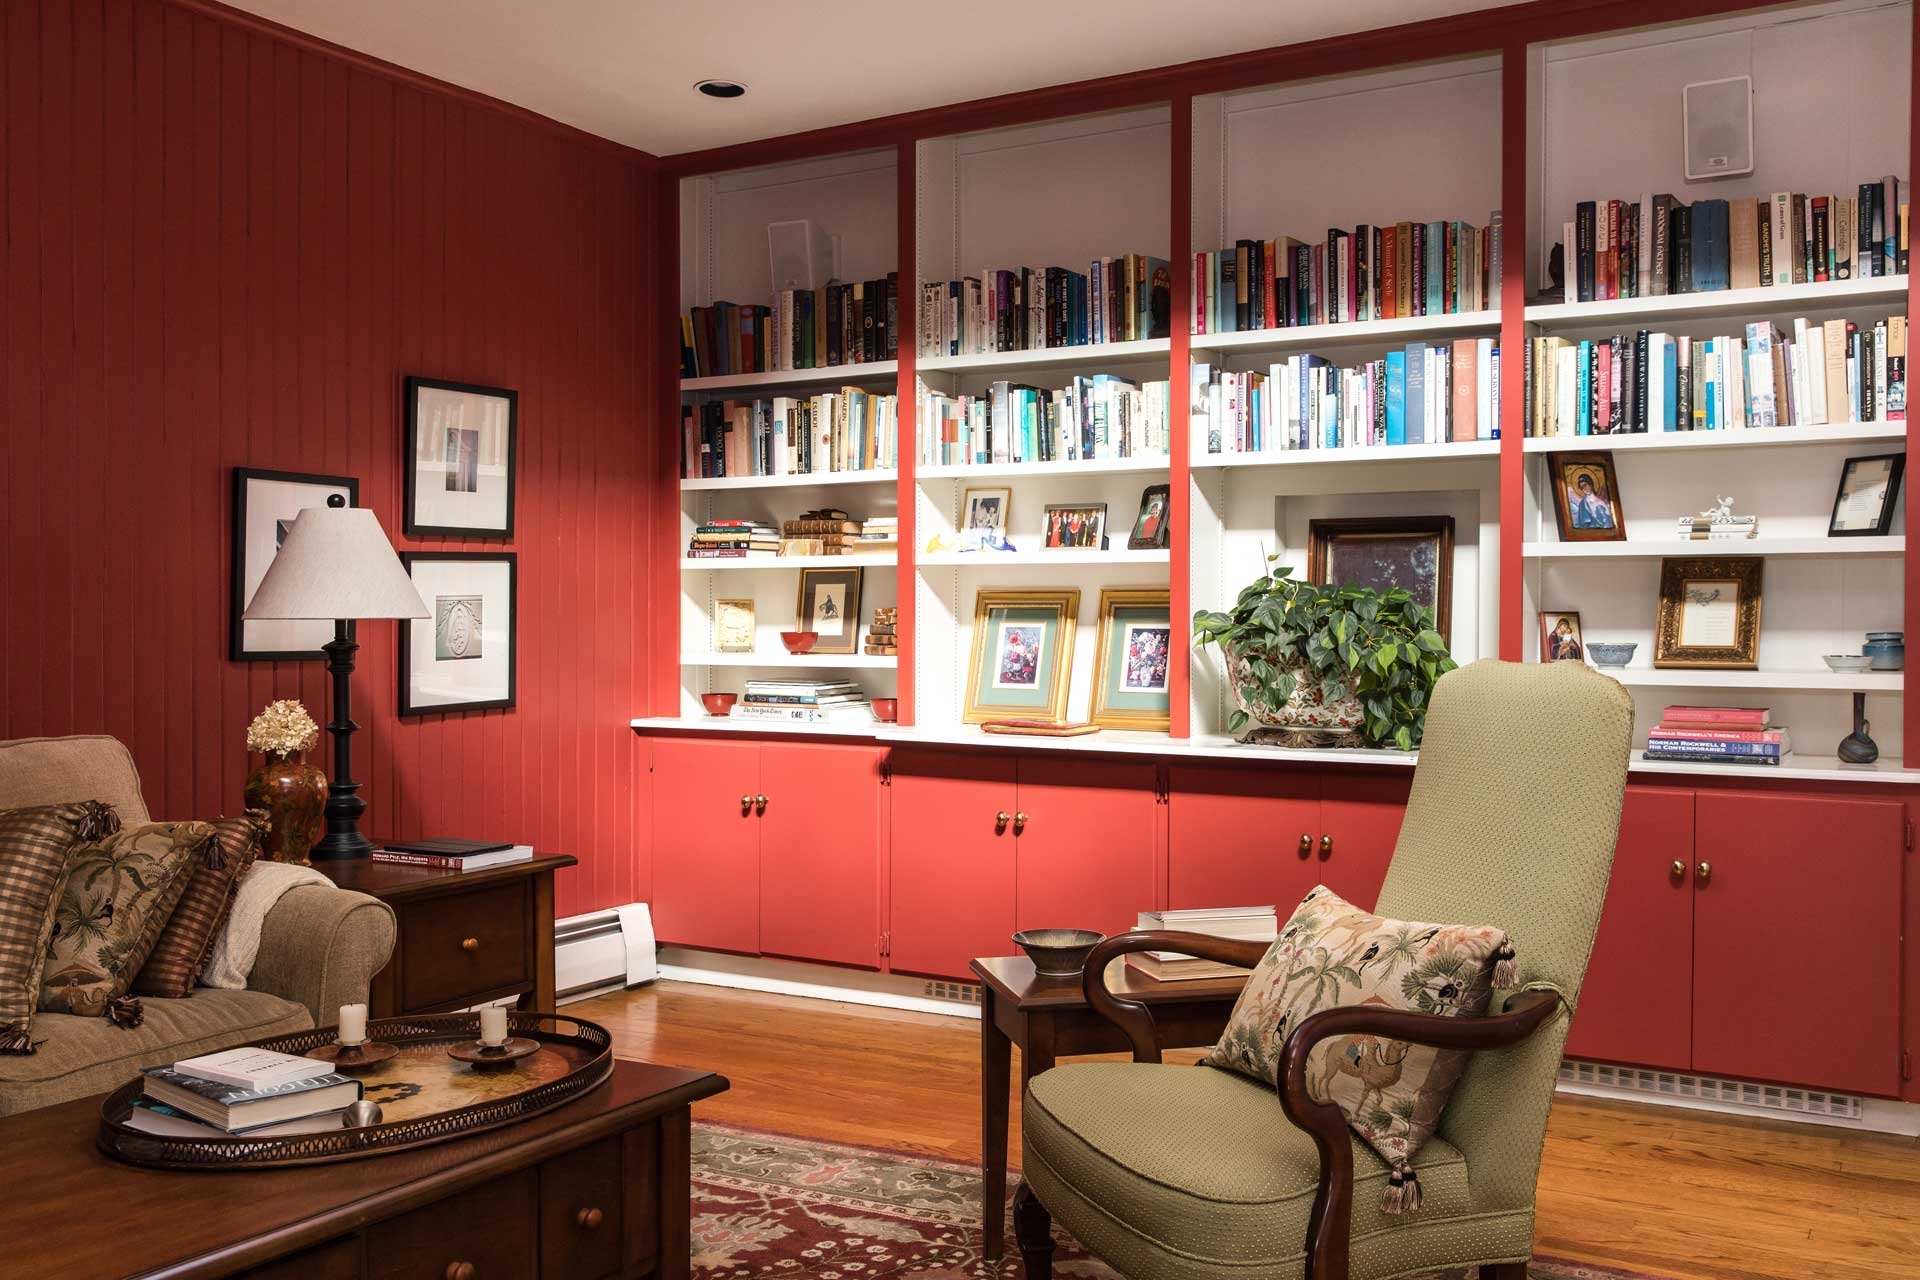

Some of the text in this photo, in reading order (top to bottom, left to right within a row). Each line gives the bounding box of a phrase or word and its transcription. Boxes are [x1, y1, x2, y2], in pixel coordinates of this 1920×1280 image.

[1839, 220, 1847, 250] Coleridge
[1385, 240, 1393, 267] Manual
[1385, 279, 1393, 296] Style
[1600, 370, 1609, 412] SELLING ALL
